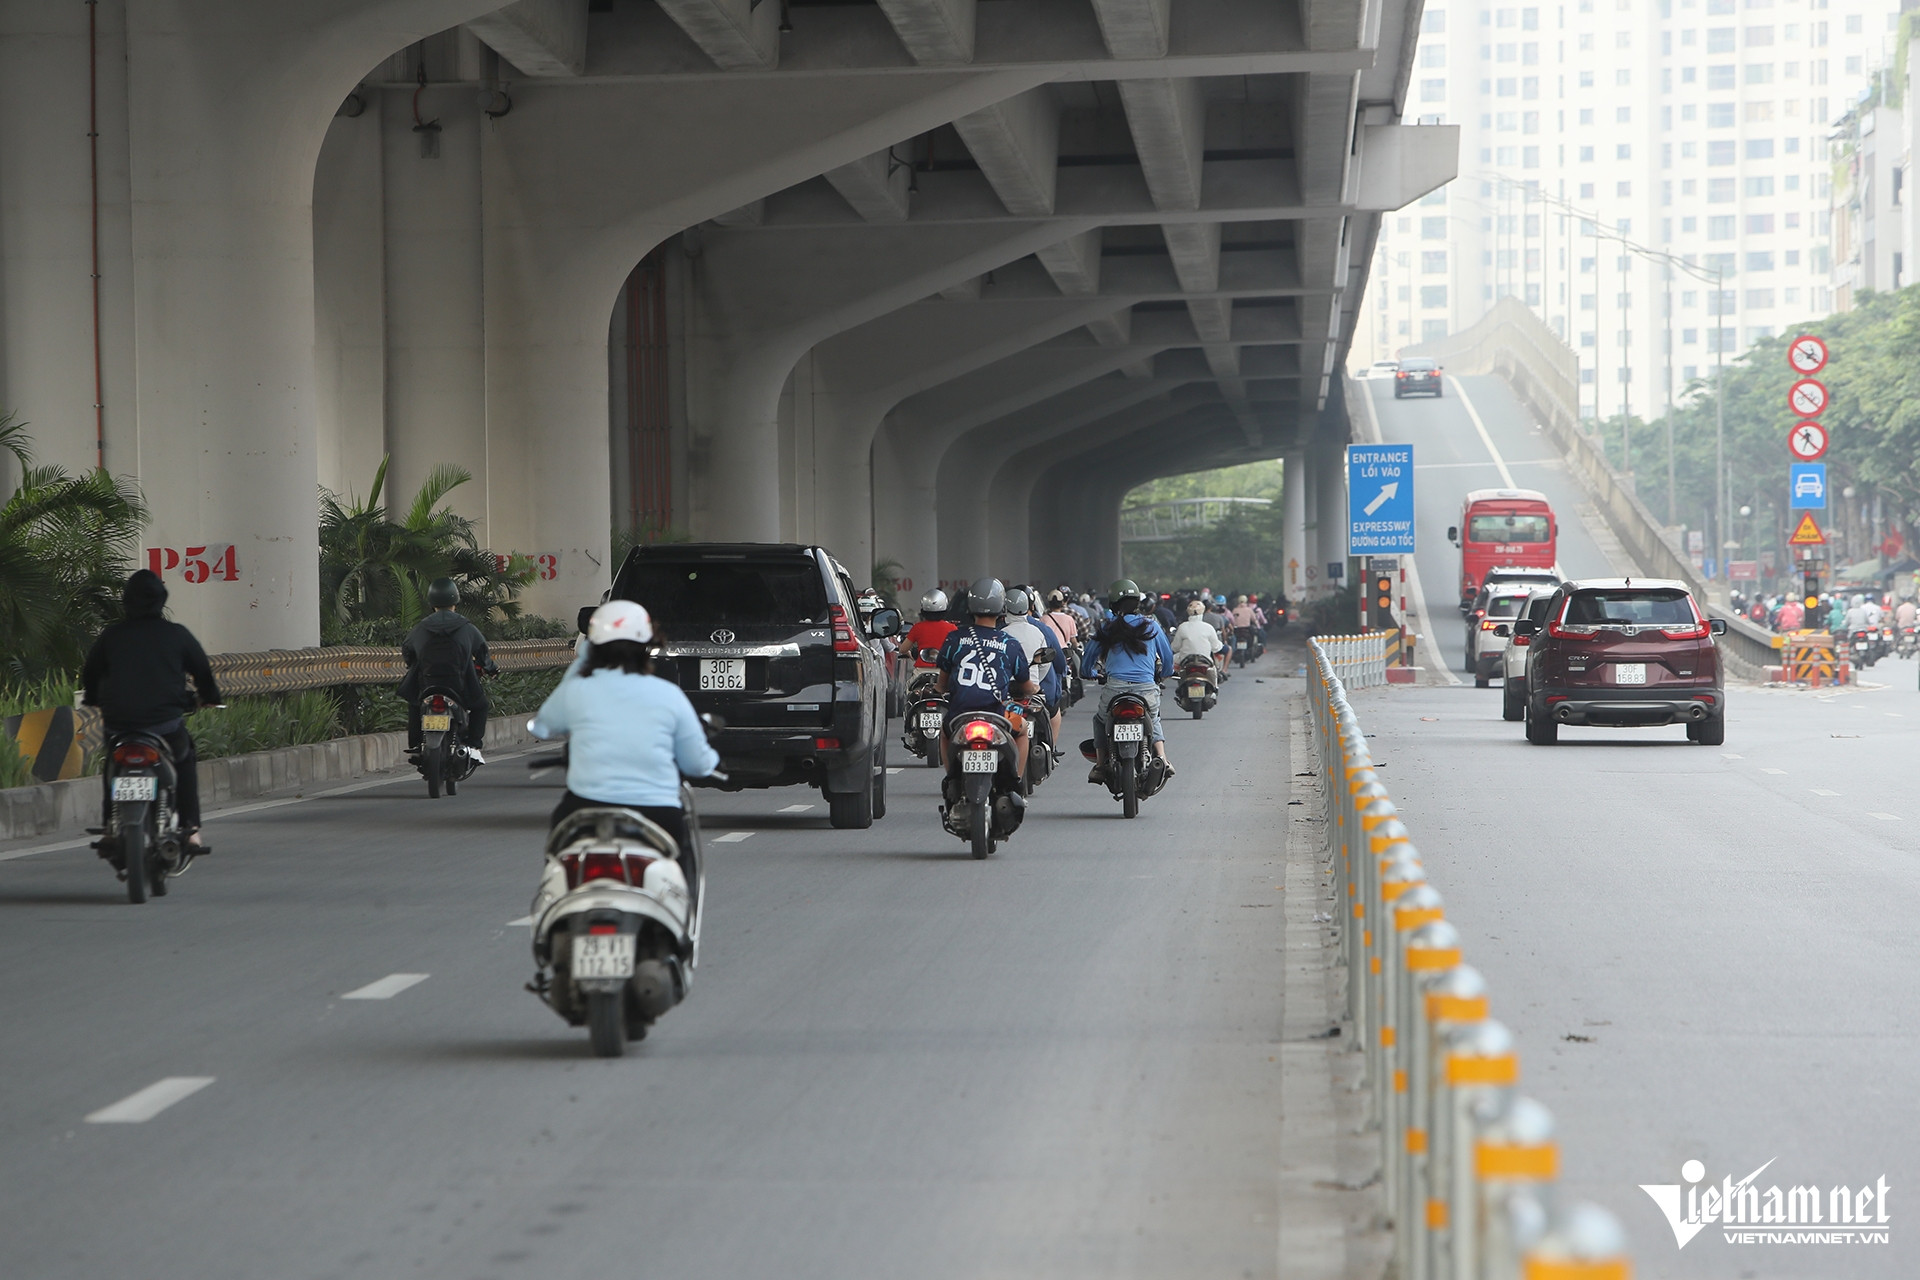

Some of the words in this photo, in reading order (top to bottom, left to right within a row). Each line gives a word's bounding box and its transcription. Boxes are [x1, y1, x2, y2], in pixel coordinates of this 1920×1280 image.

[1353, 452, 1408, 463] ENTRANCE
[1381, 464, 1401, 477] VÀO
[1353, 521, 1411, 532] EXPRESSWAY
[1380, 536, 1397, 546] CAO
[1398, 531, 1414, 546] TỐC
[147, 545, 240, 583] P54
[710, 661, 734, 674] 30F
[1623, 665, 1638, 673] 30F
[701, 675, 743, 689] 919.62
[964, 762, 995, 771] 033.30
